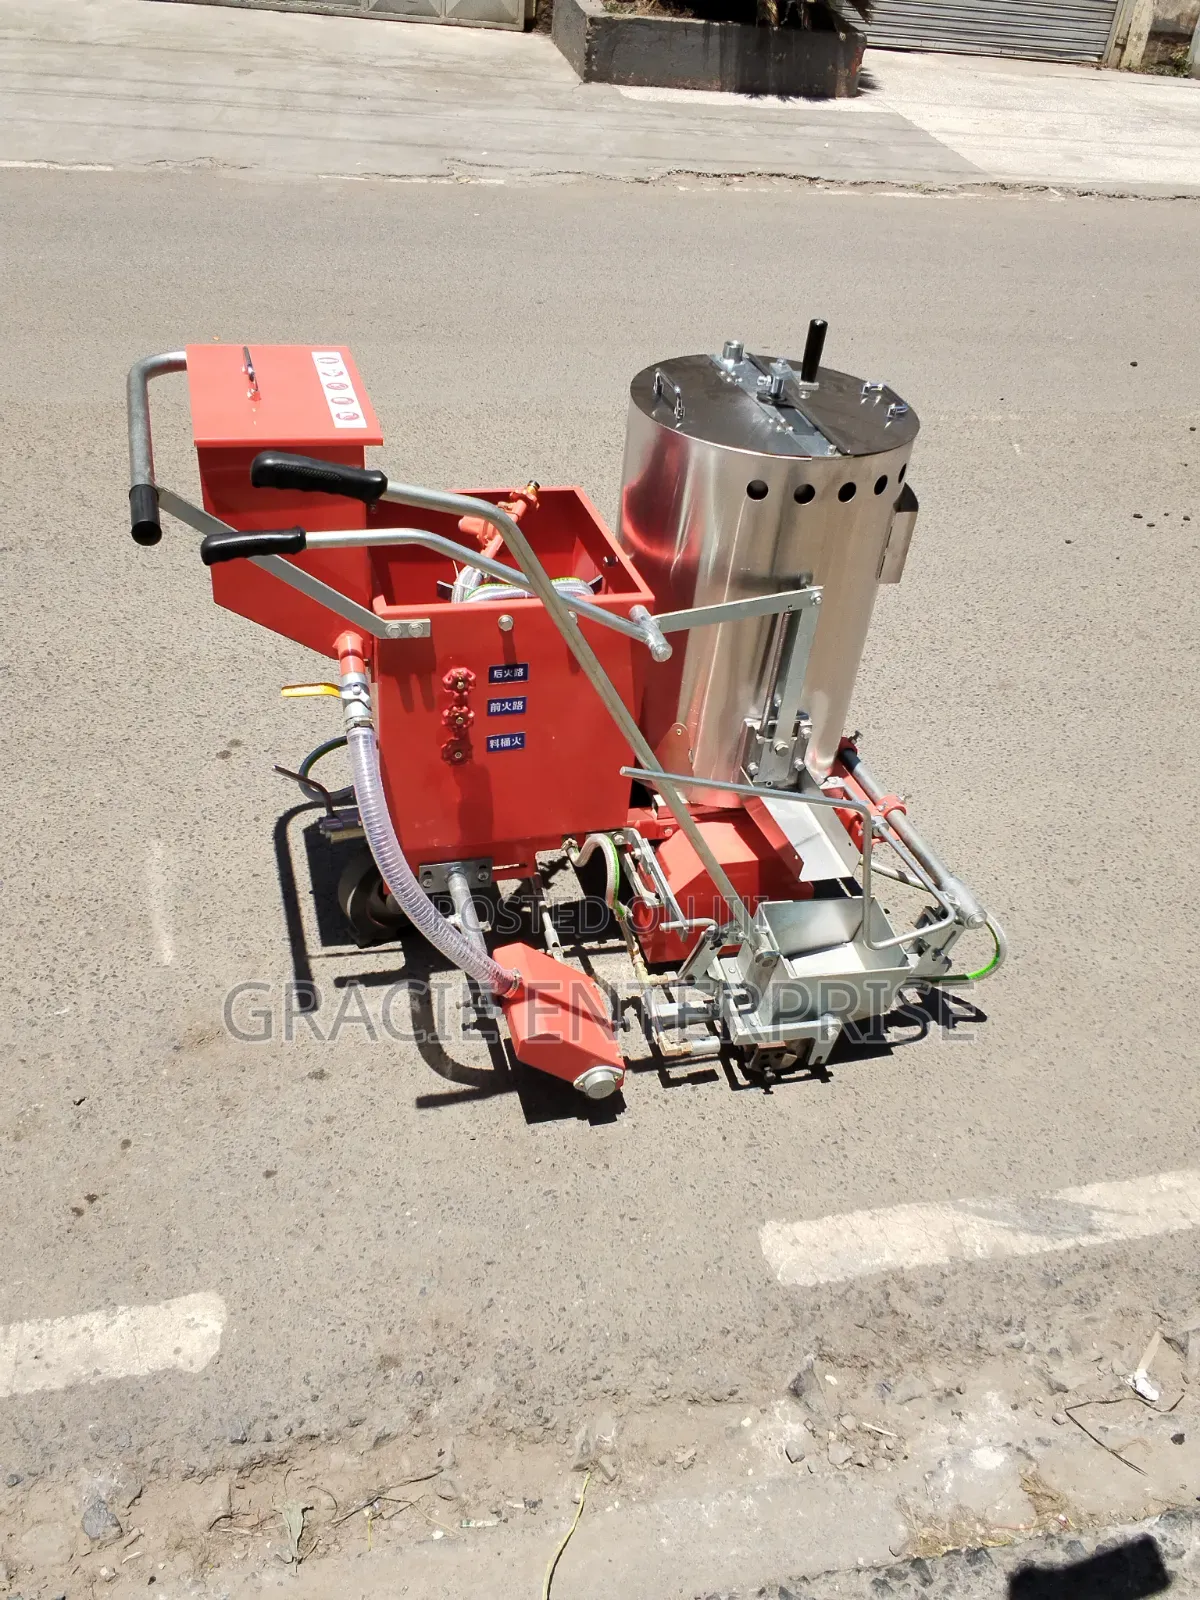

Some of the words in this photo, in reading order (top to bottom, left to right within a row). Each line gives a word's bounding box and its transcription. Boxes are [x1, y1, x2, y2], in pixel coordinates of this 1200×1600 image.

[493, 667, 524, 679] 后火路
[490, 700, 524, 713] 前火路
[489, 736, 522, 749] 料桶火
